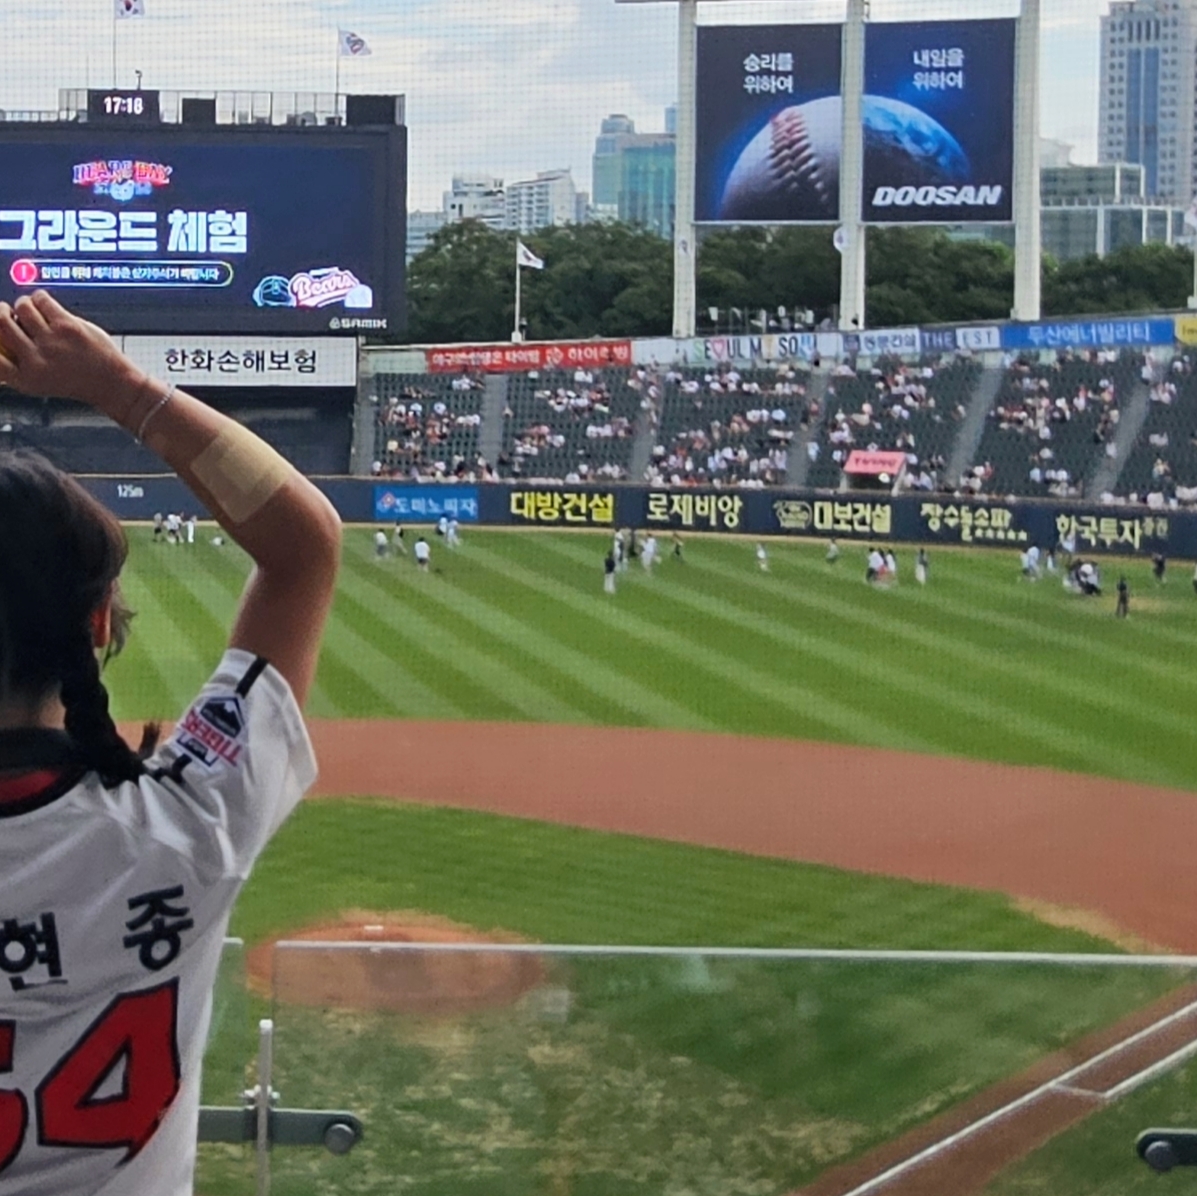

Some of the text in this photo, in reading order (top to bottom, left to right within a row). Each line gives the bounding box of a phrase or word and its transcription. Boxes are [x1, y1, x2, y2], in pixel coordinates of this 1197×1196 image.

[743, 53, 794, 73] 승리를
[913, 48, 964, 68] 내일을
[743, 75, 794, 94] 위하여
[913, 70, 964, 91] 위하여
[872, 185, 1002, 206] DOOSAN
[167, 209, 248, 252] 체험
[924, 331, 953, 348] THE
[1028, 321, 1150, 345] 두산에너빌리티
[164, 348, 316, 374] 한화손해보험
[117, 484, 144, 498] 125m
[394, 497, 478, 517] 도미노피자
[510, 492, 614, 523] 대방건설
[647, 493, 742, 528] 로제비앙
[814, 501, 891, 533] 대보건설
[181, 706, 242, 767] TIGERS
